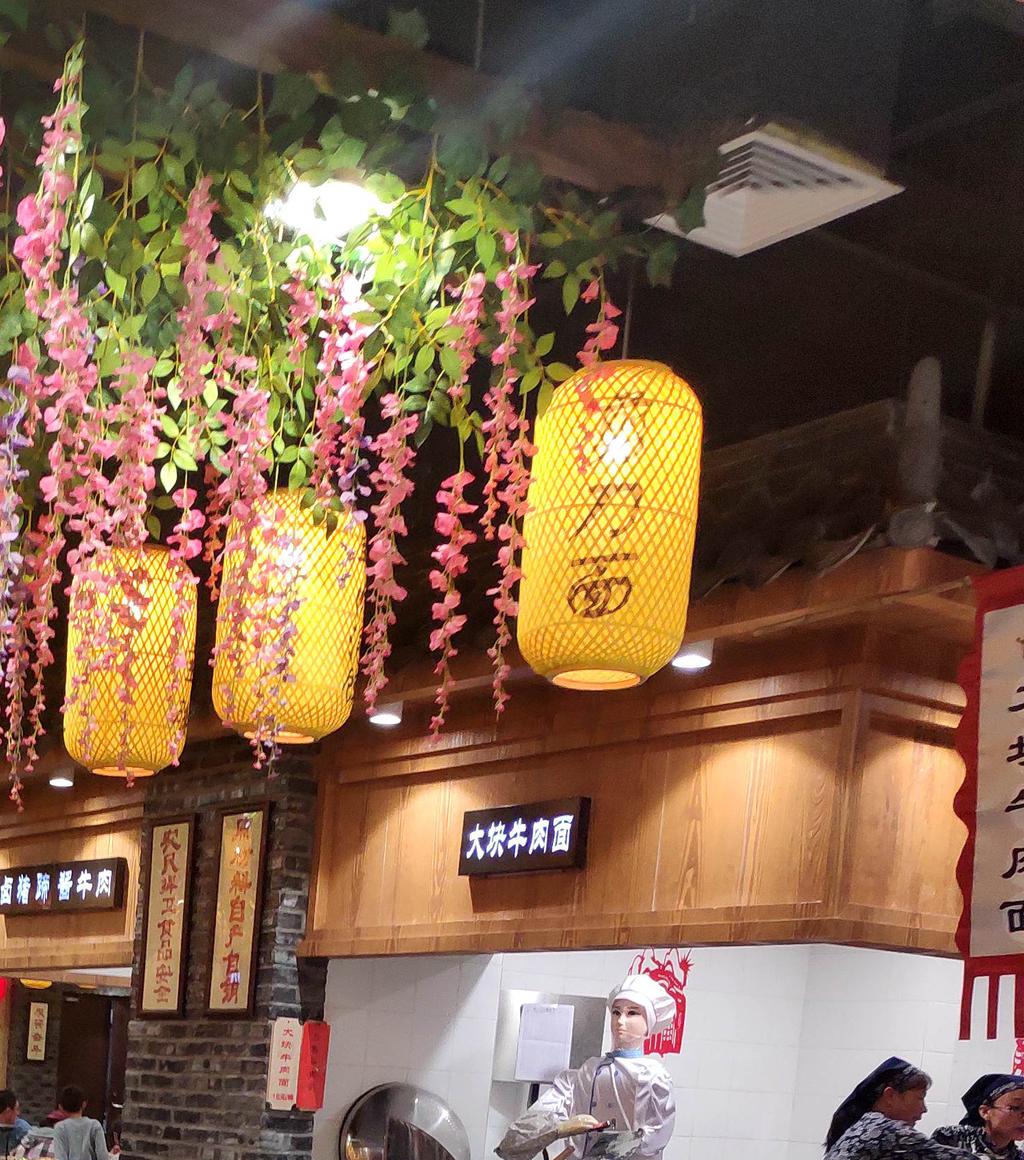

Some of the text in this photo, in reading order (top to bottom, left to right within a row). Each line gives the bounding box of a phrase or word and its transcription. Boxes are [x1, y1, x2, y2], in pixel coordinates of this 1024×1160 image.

[466, 814, 574, 861] 大块牛肉面
